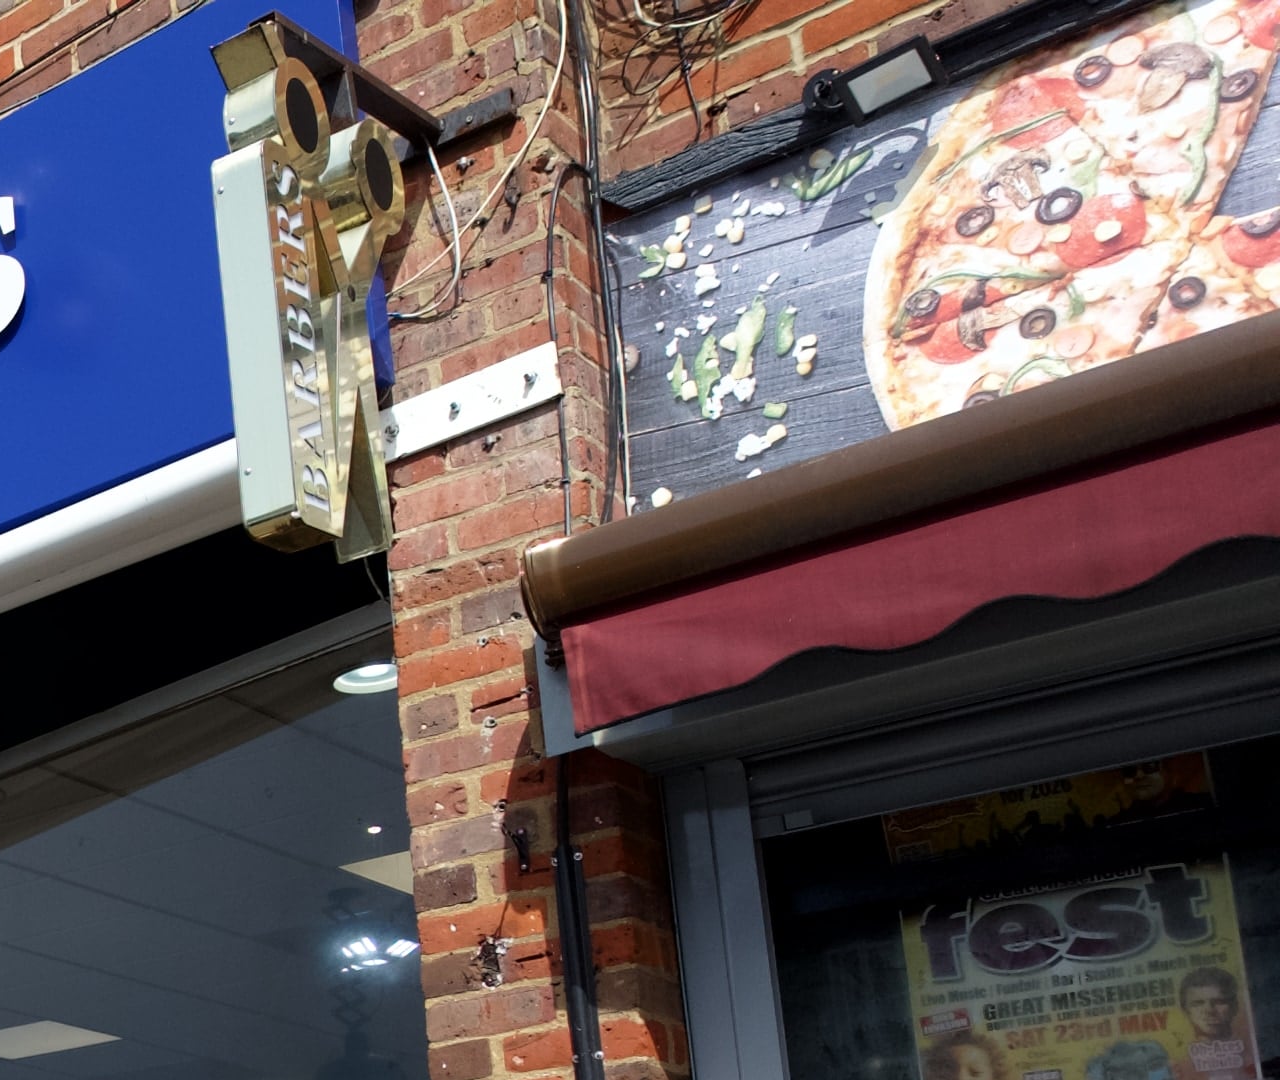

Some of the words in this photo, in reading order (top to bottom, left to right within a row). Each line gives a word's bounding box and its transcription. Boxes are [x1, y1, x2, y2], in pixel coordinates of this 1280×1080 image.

[272, 159, 331, 513] BARBERS
[921, 863, 1213, 982] fest
[984, 996, 1045, 1020] GREAT
[1051, 978, 1175, 1008] MISSENDEN
[1052, 975, 1074, 987] Bar
[1006, 1026, 1047, 1050] SAT
[1054, 1018, 1112, 1043] 23rd
[1118, 1011, 1170, 1035] MAY
